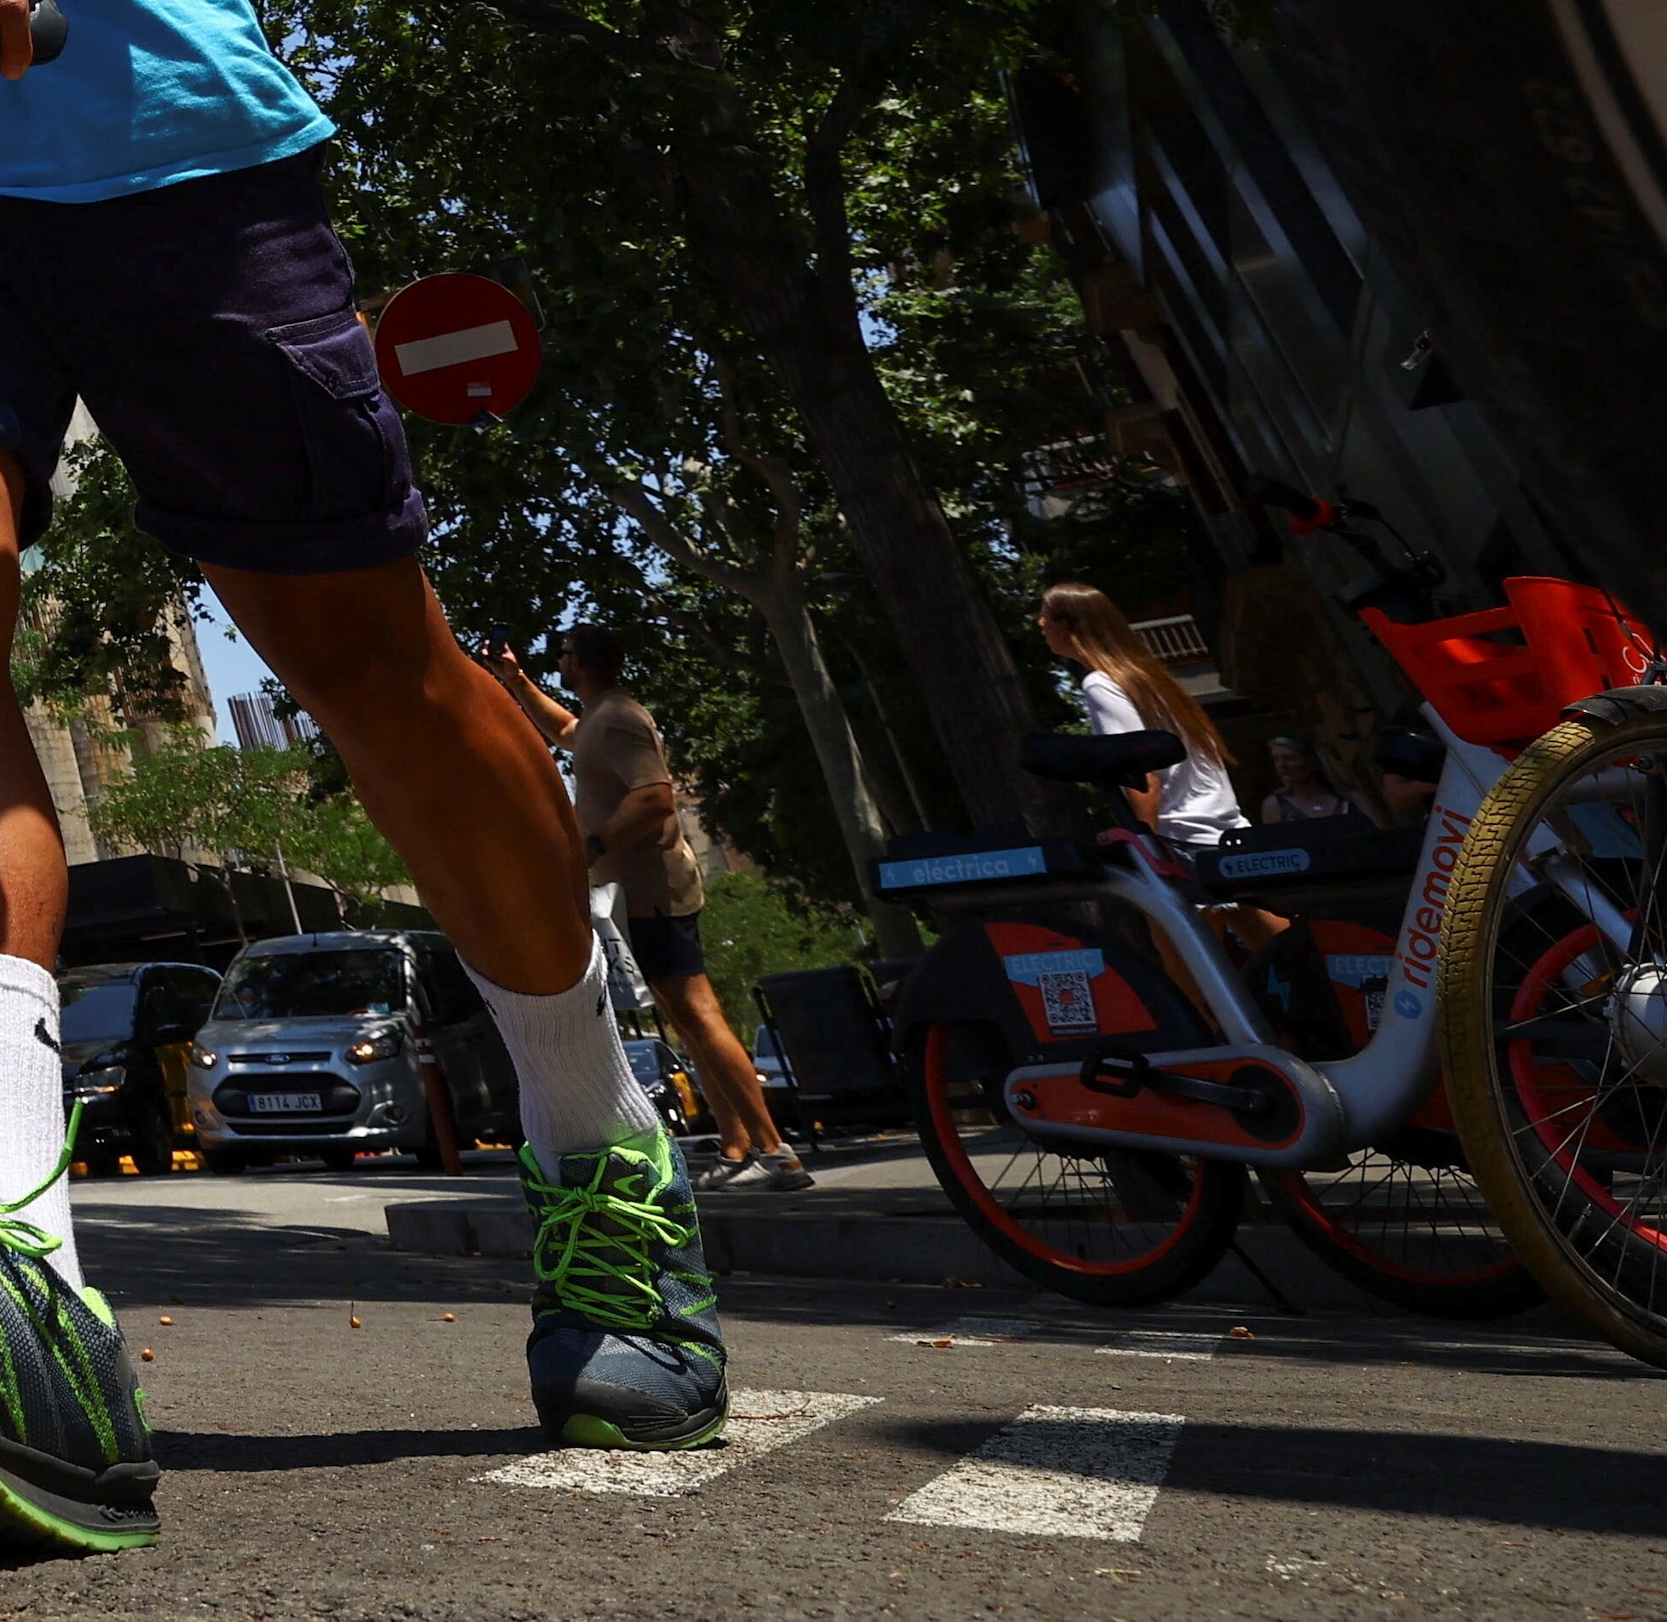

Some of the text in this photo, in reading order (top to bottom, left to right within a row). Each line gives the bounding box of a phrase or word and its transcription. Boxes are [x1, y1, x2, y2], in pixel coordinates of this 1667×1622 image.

[912, 855, 1009, 883] eléctrica
[1238, 853, 1300, 873] ELECTRIC
[1397, 805, 1472, 988] ridemovi
[1011, 951, 1095, 974] ELECTRIC
[1336, 957, 1394, 974] ELECT
[258, 1095, 320, 1110] 8114 JCX
